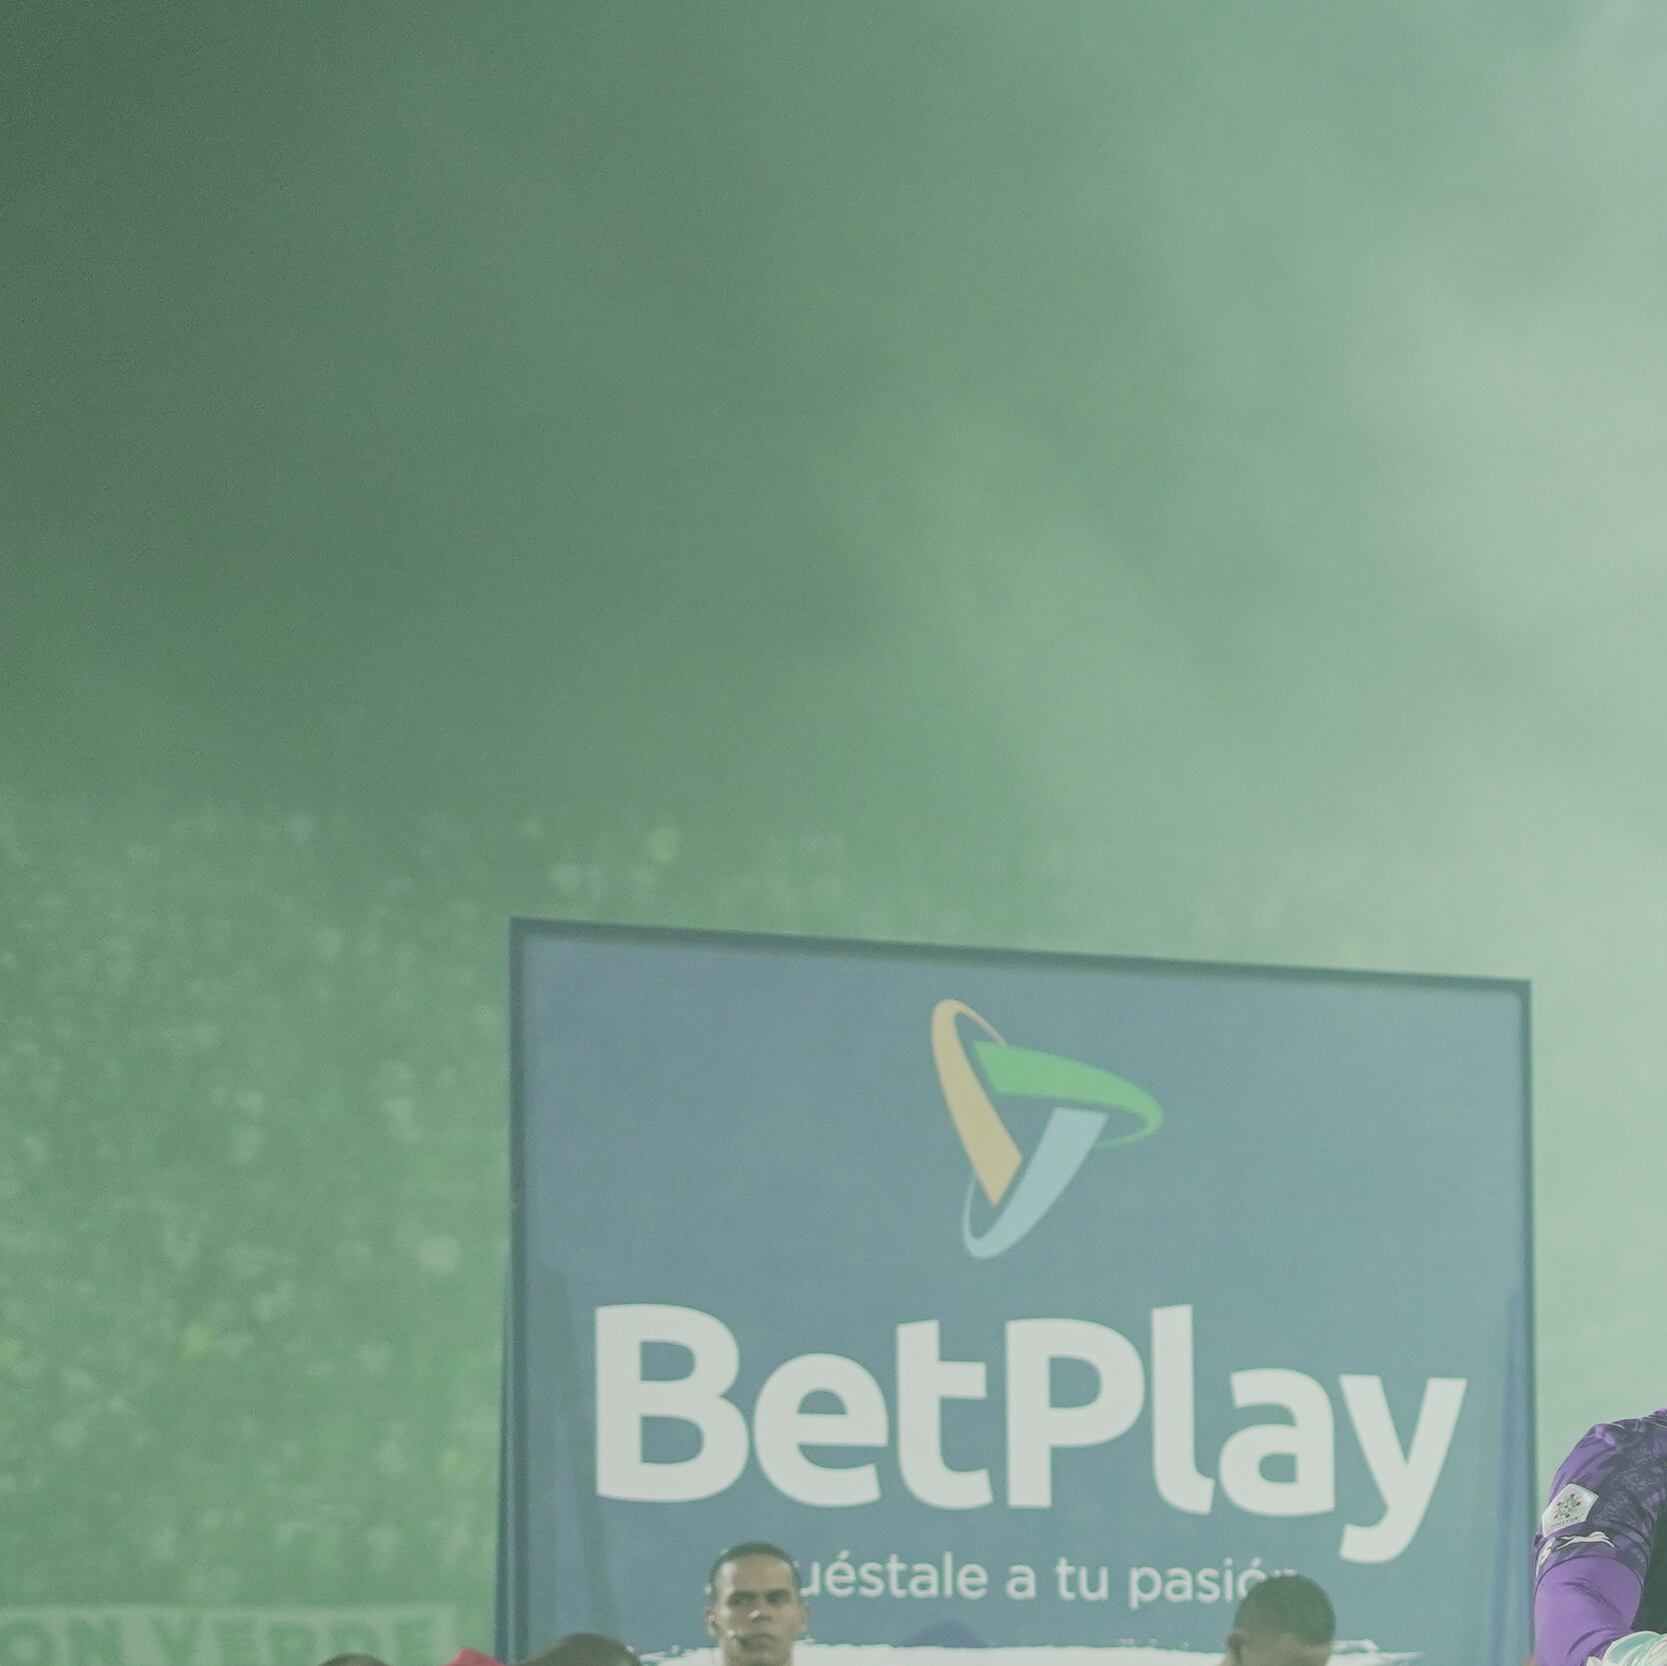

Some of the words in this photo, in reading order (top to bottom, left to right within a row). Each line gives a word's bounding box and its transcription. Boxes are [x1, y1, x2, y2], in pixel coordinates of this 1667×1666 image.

[596, 1303, 1467, 1563] BetPlay
[797, 1551, 988, 1599] uéstale
[1006, 1564, 1037, 1599] a
[1055, 1556, 1109, 1601] tu
[1130, 1557, 1298, 1609] pasió
